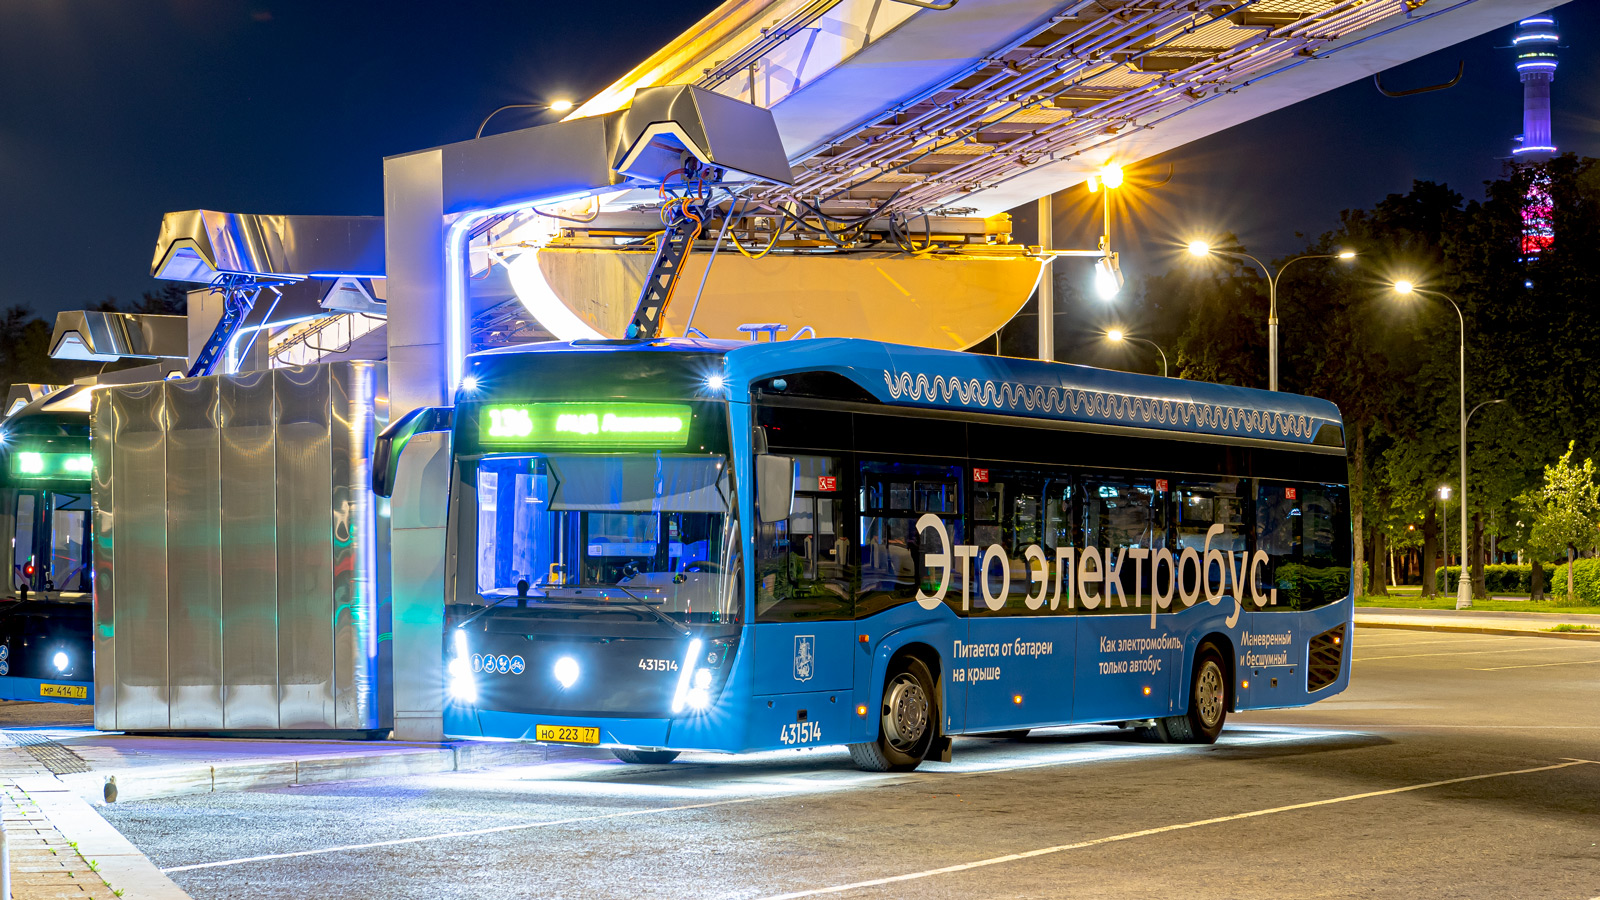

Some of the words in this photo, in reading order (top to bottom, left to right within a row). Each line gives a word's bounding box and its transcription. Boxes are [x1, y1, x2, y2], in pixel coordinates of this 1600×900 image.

[915, 513, 1010, 610] Это
[1024, 524, 1277, 629] электробус.
[953, 640, 1000, 659] Питается
[1001, 643, 1013, 656] от
[1014, 637, 1053, 659] батареи
[1099, 635, 1116, 653] Как
[1117, 632, 1183, 654] электромобиль,
[1240, 630, 1292, 649] Маневренный
[638, 658, 679, 672] 431514
[1098, 661, 1128, 675] только
[1129, 655, 1162, 675] автобус
[1240, 655, 1245, 666] и
[1246, 650, 1287, 669] бесшумный
[952, 668, 965, 682] на
[967, 666, 1001, 686] крыше
[57, 686, 72, 696] 414
[558, 728, 579, 740] 223
[585, 728, 595, 738] 77
[780, 721, 822, 745] 431514
